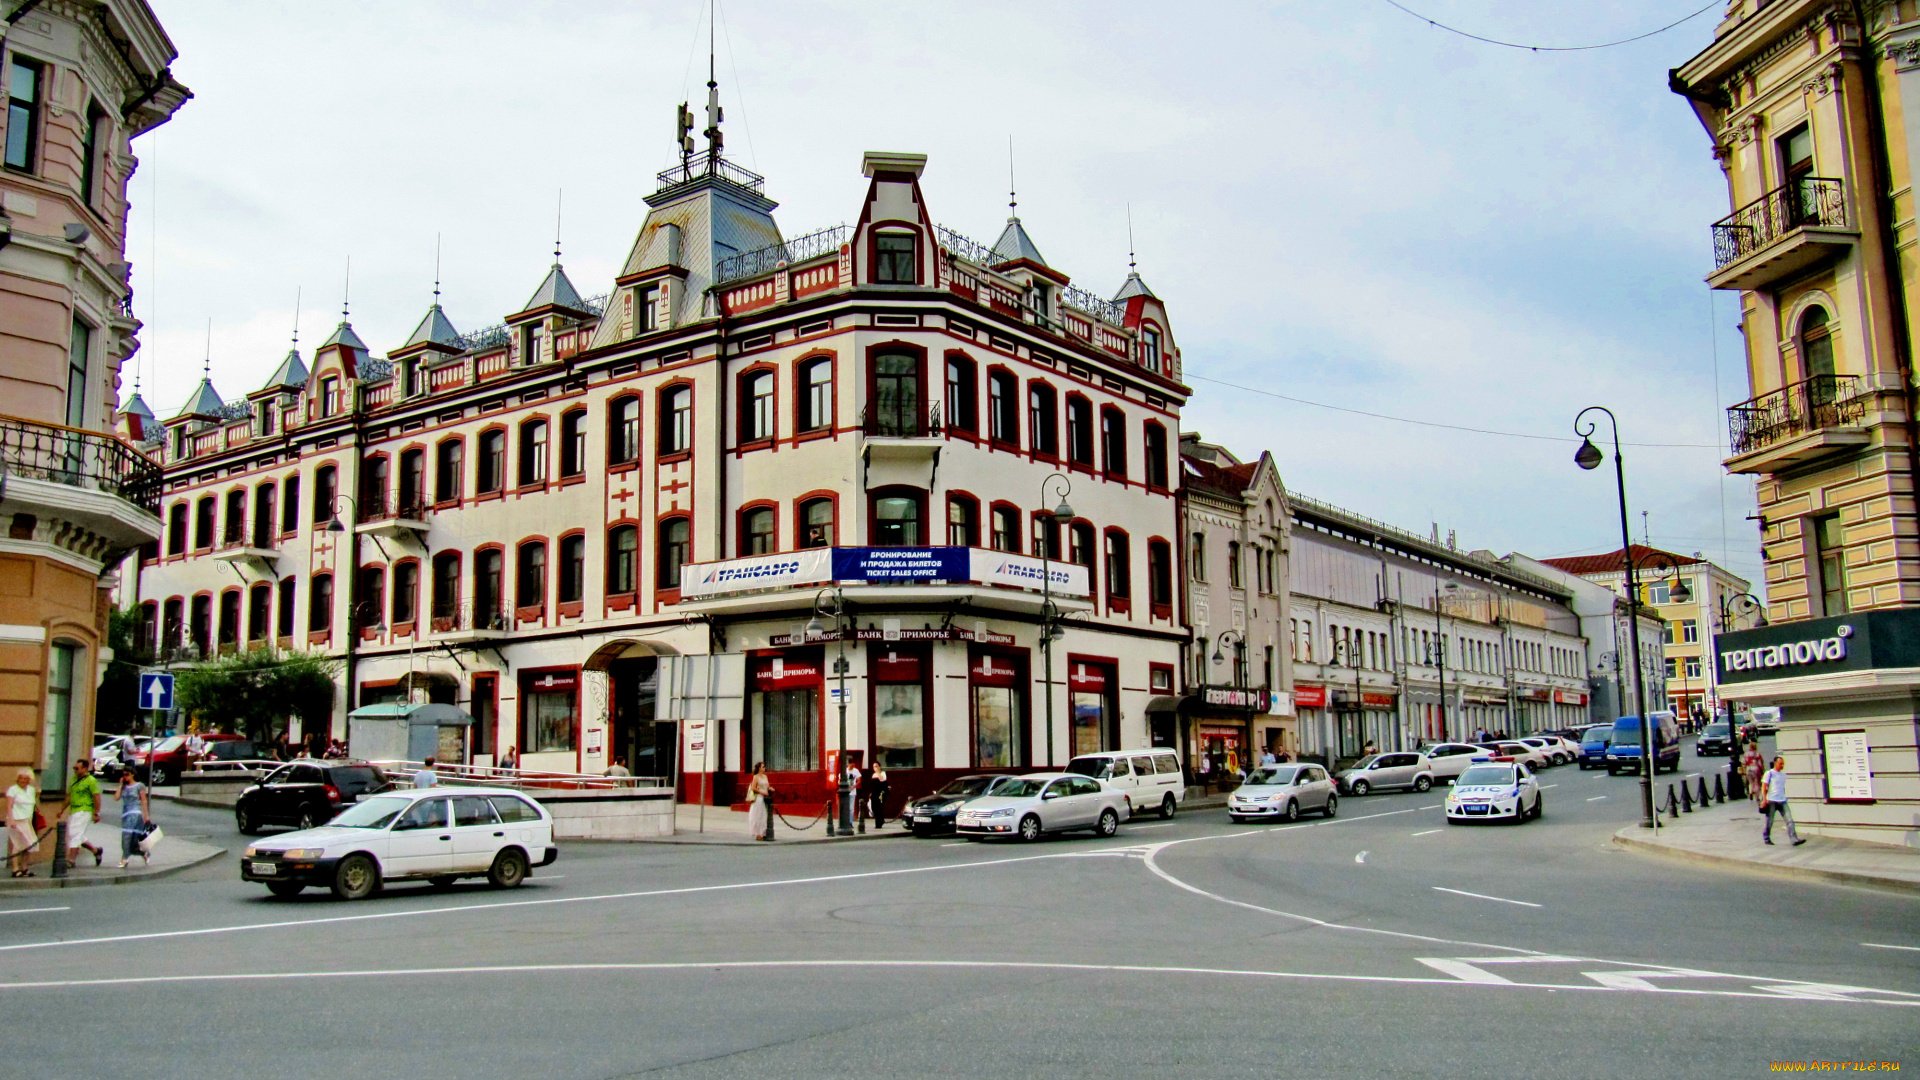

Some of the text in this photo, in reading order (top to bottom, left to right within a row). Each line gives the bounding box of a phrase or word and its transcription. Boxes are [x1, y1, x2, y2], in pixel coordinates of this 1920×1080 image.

[718, 561, 800, 582] ТРАНСАЭРО
[857, 631, 882, 639] БАНК
[784, 668, 816, 677] ПРИМОРЬЕ
